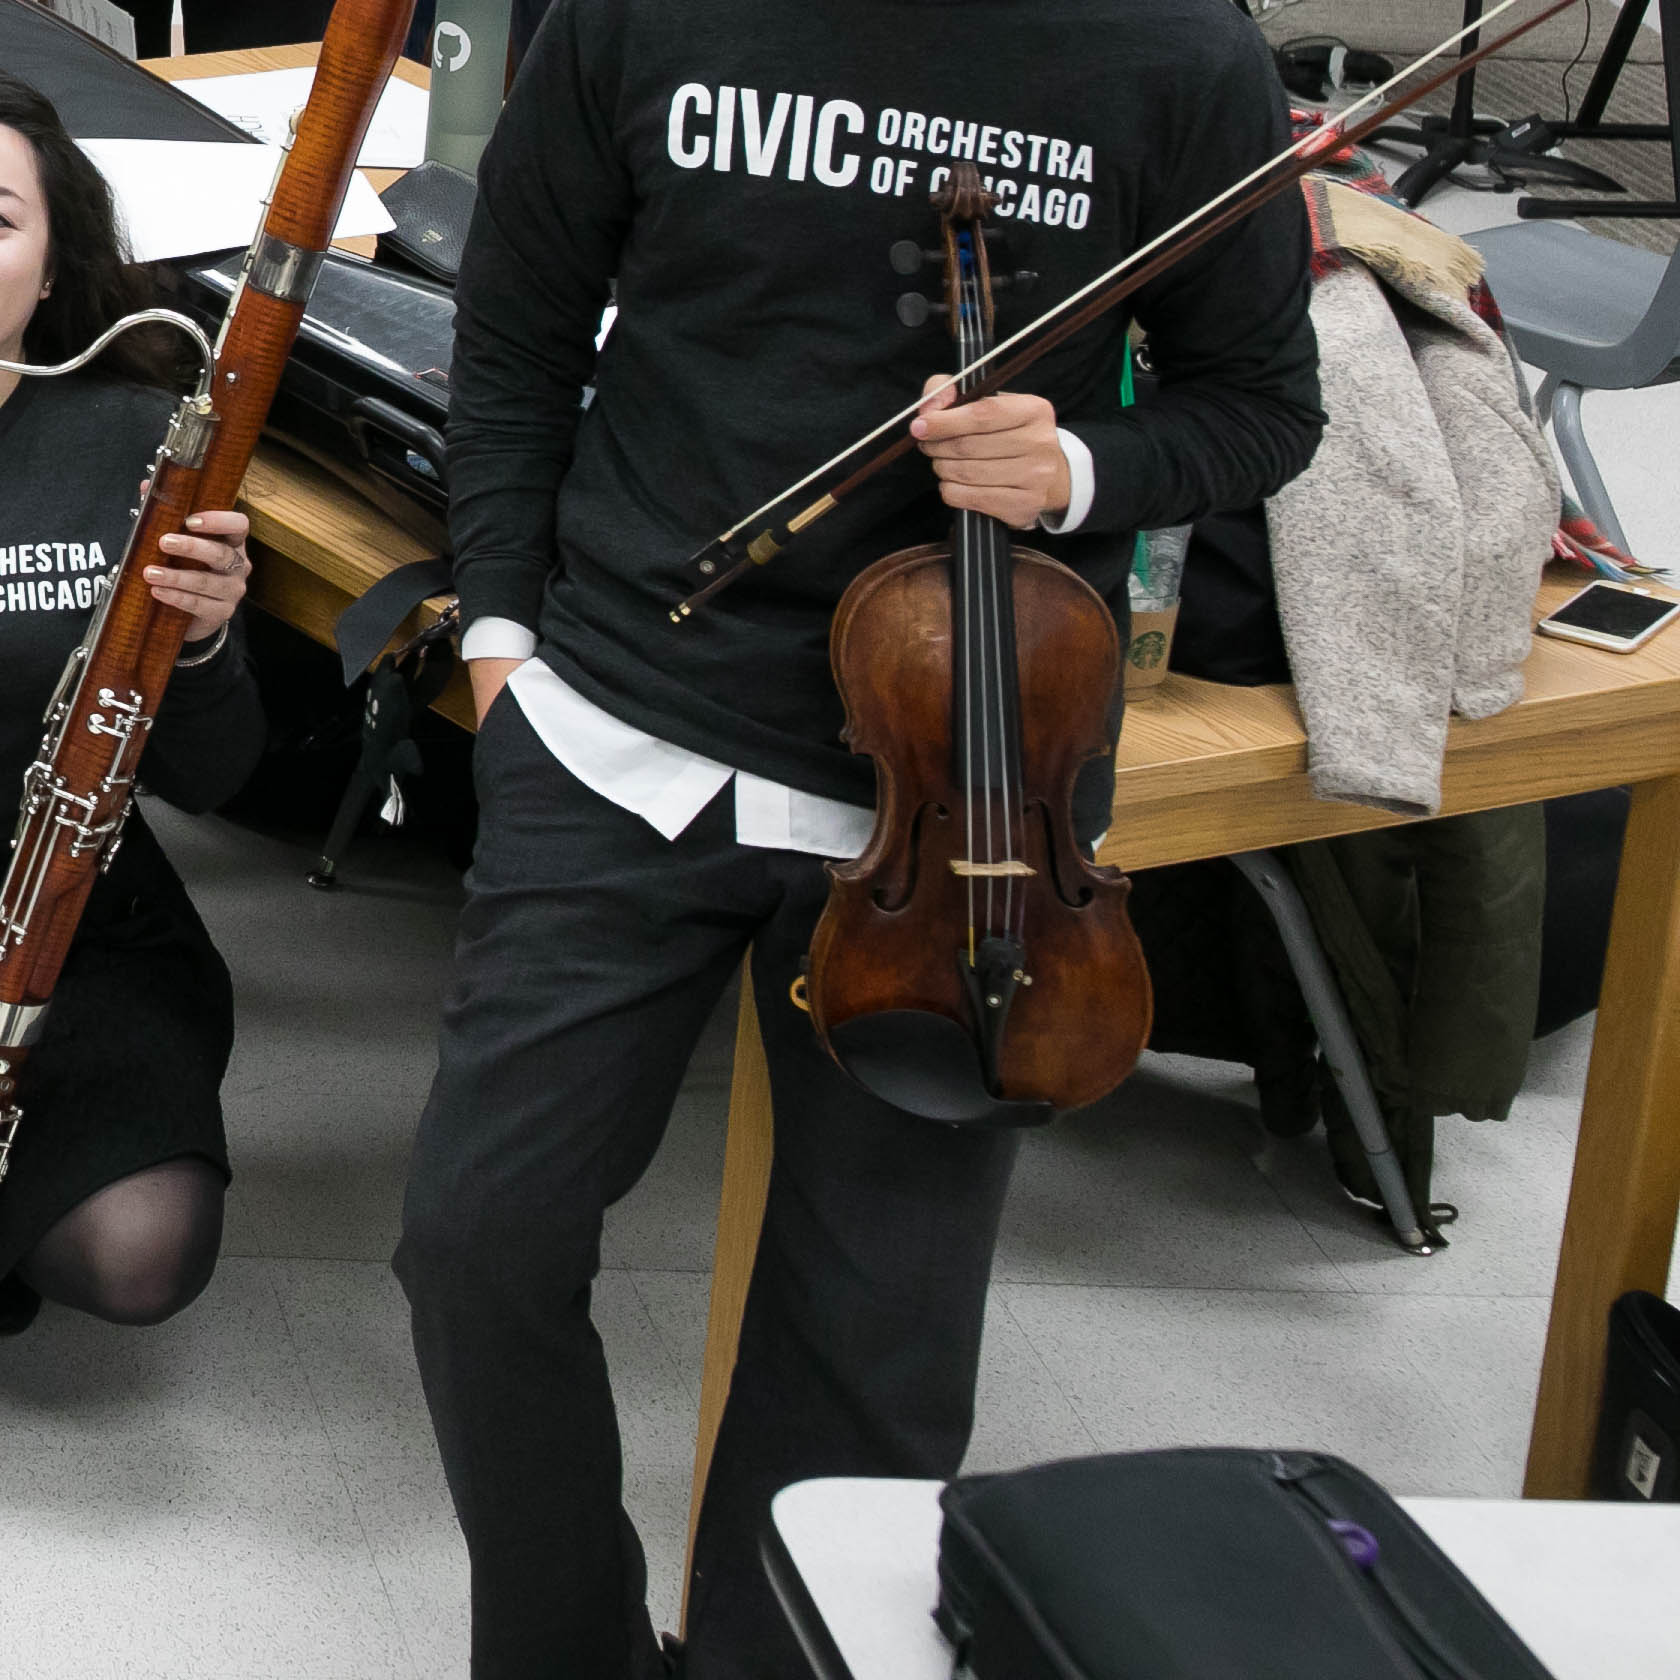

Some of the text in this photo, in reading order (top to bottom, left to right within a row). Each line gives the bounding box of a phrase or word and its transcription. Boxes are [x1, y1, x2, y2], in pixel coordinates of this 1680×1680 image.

[667, 82, 865, 188] CIVIC
[877, 107, 1094, 183] ORCHESTRA
[869, 155, 1091, 230] OF CCAGO
